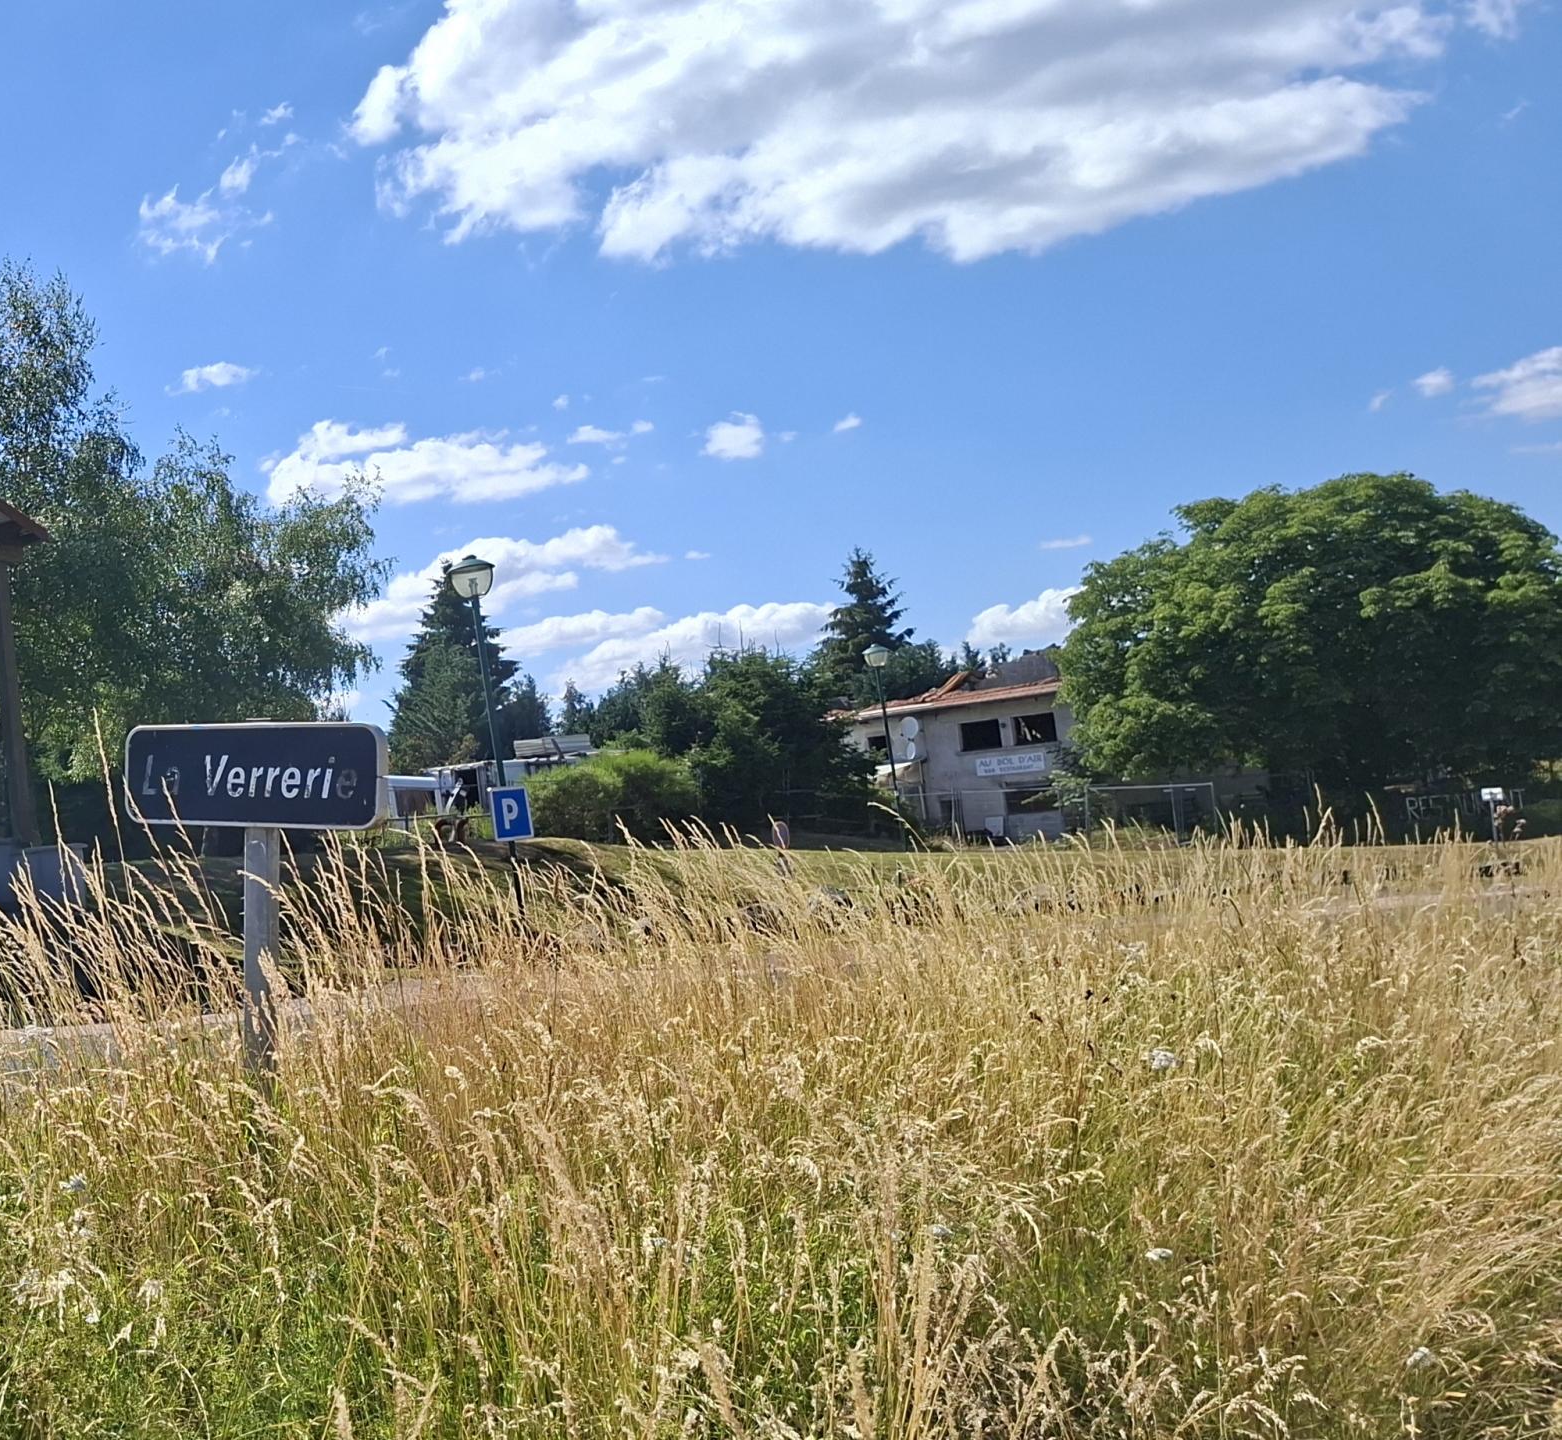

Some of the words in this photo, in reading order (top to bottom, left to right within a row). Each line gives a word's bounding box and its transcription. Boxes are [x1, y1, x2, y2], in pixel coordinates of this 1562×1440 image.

[142, 754, 181, 796] La
[204, 754, 358, 799] Verrerie
[501, 798, 518, 830] P
